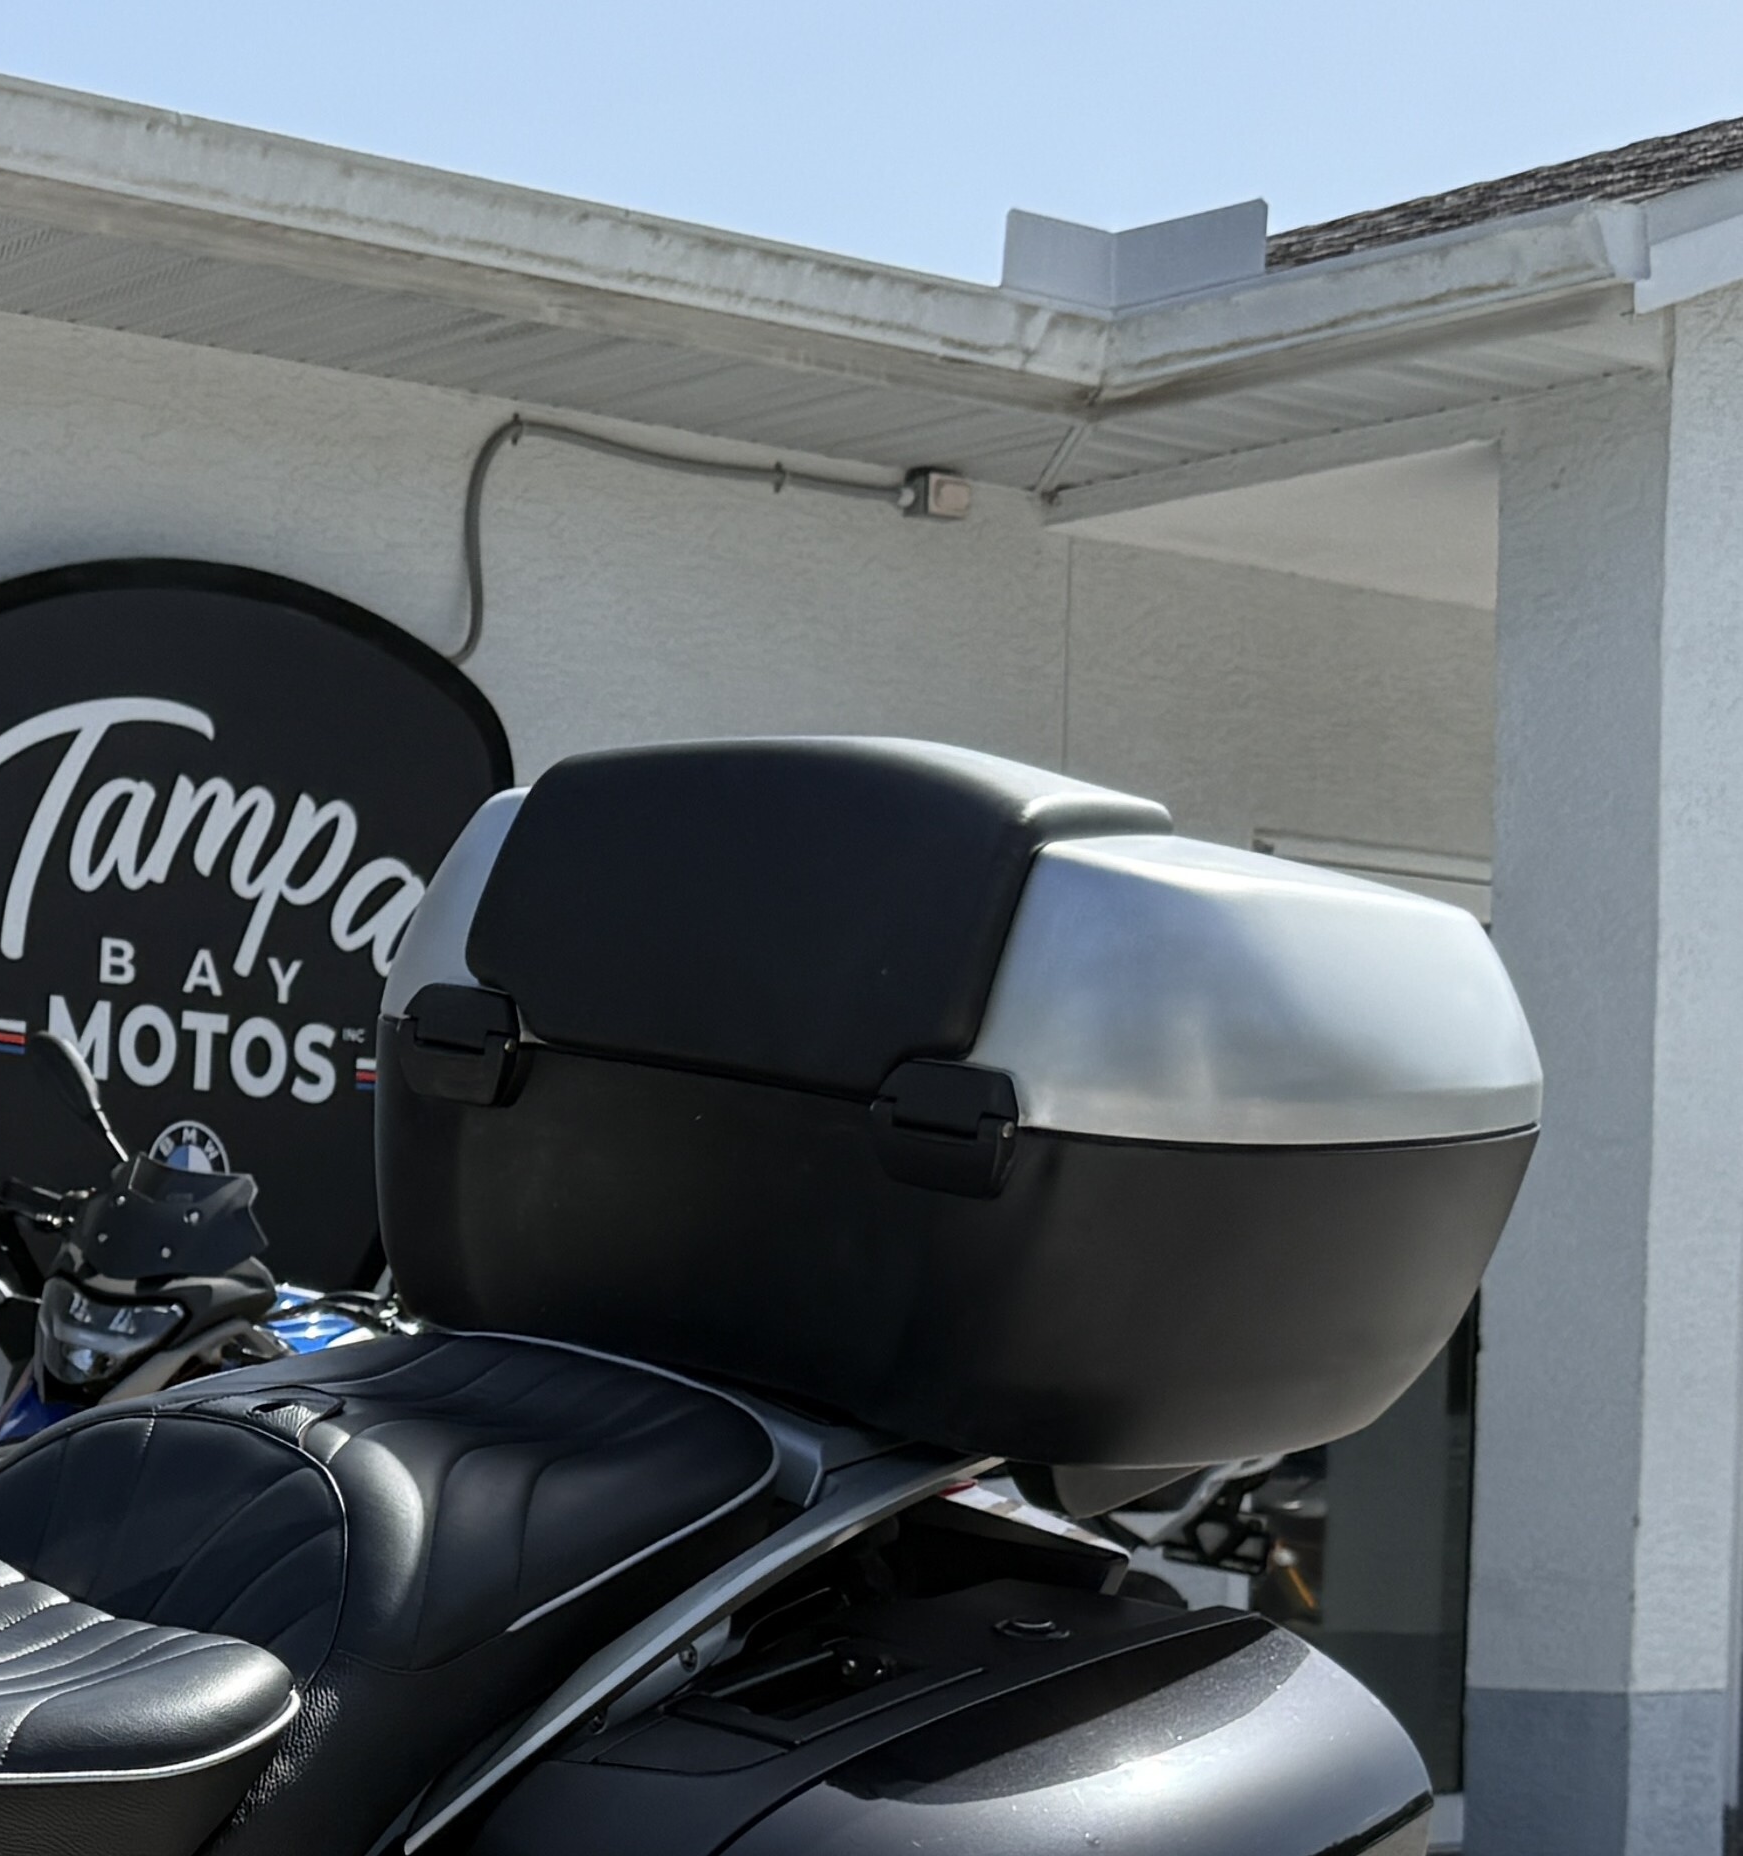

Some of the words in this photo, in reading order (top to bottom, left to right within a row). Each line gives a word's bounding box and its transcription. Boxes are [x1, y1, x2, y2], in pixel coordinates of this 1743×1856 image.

[100, 937, 303, 1004] BAY
[49, 994, 337, 1104] MOTOS
[342, 1027, 366, 1044] INC
[159, 1127, 219, 1160] BMW
